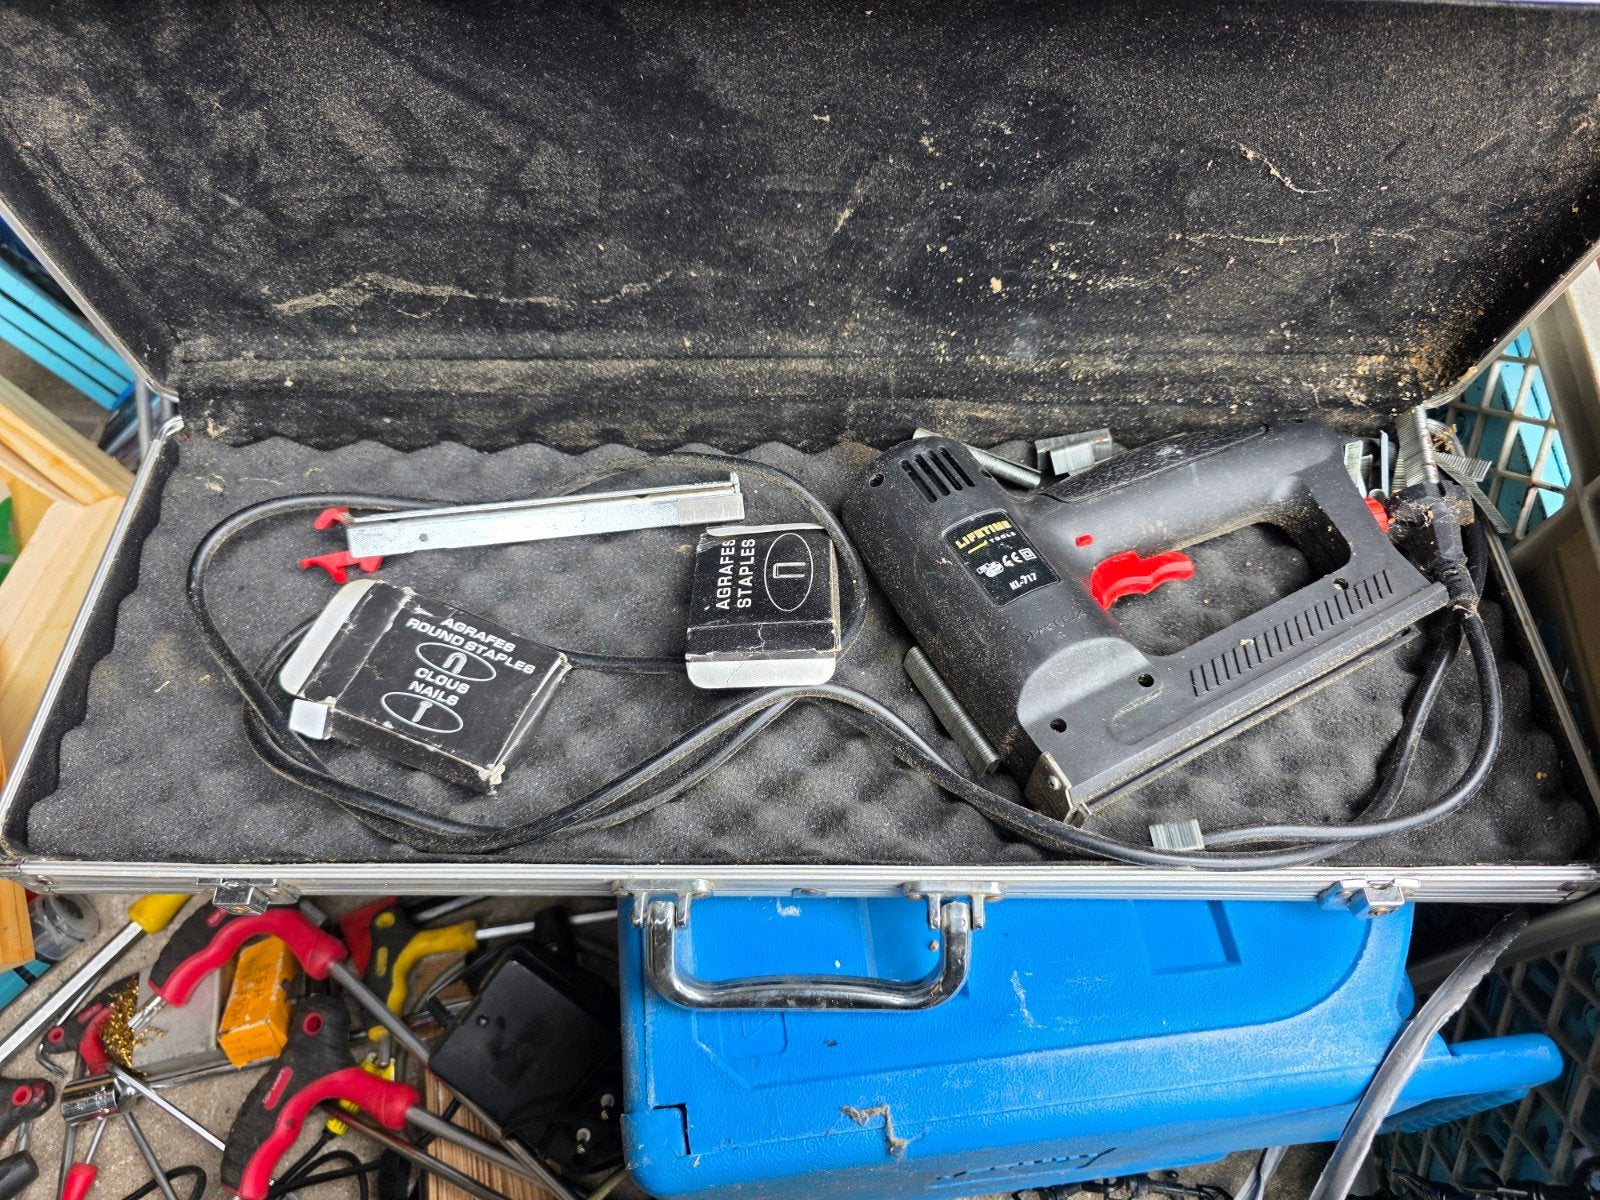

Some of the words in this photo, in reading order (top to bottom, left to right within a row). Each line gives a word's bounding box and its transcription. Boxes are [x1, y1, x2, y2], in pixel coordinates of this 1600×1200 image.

[955, 521, 1012, 549] LIFETIME
[989, 531, 1016, 543] TOOLS
[715, 539, 736, 610] AGRAFES
[736, 538, 756, 608] STAPLES
[405, 617, 465, 647] ROUND
[464, 641, 536, 675] STAPLES
[440, 618, 516, 652] AGRAFES
[408, 680, 460, 707] NAILS
[414, 667, 471, 694] CLOUS
